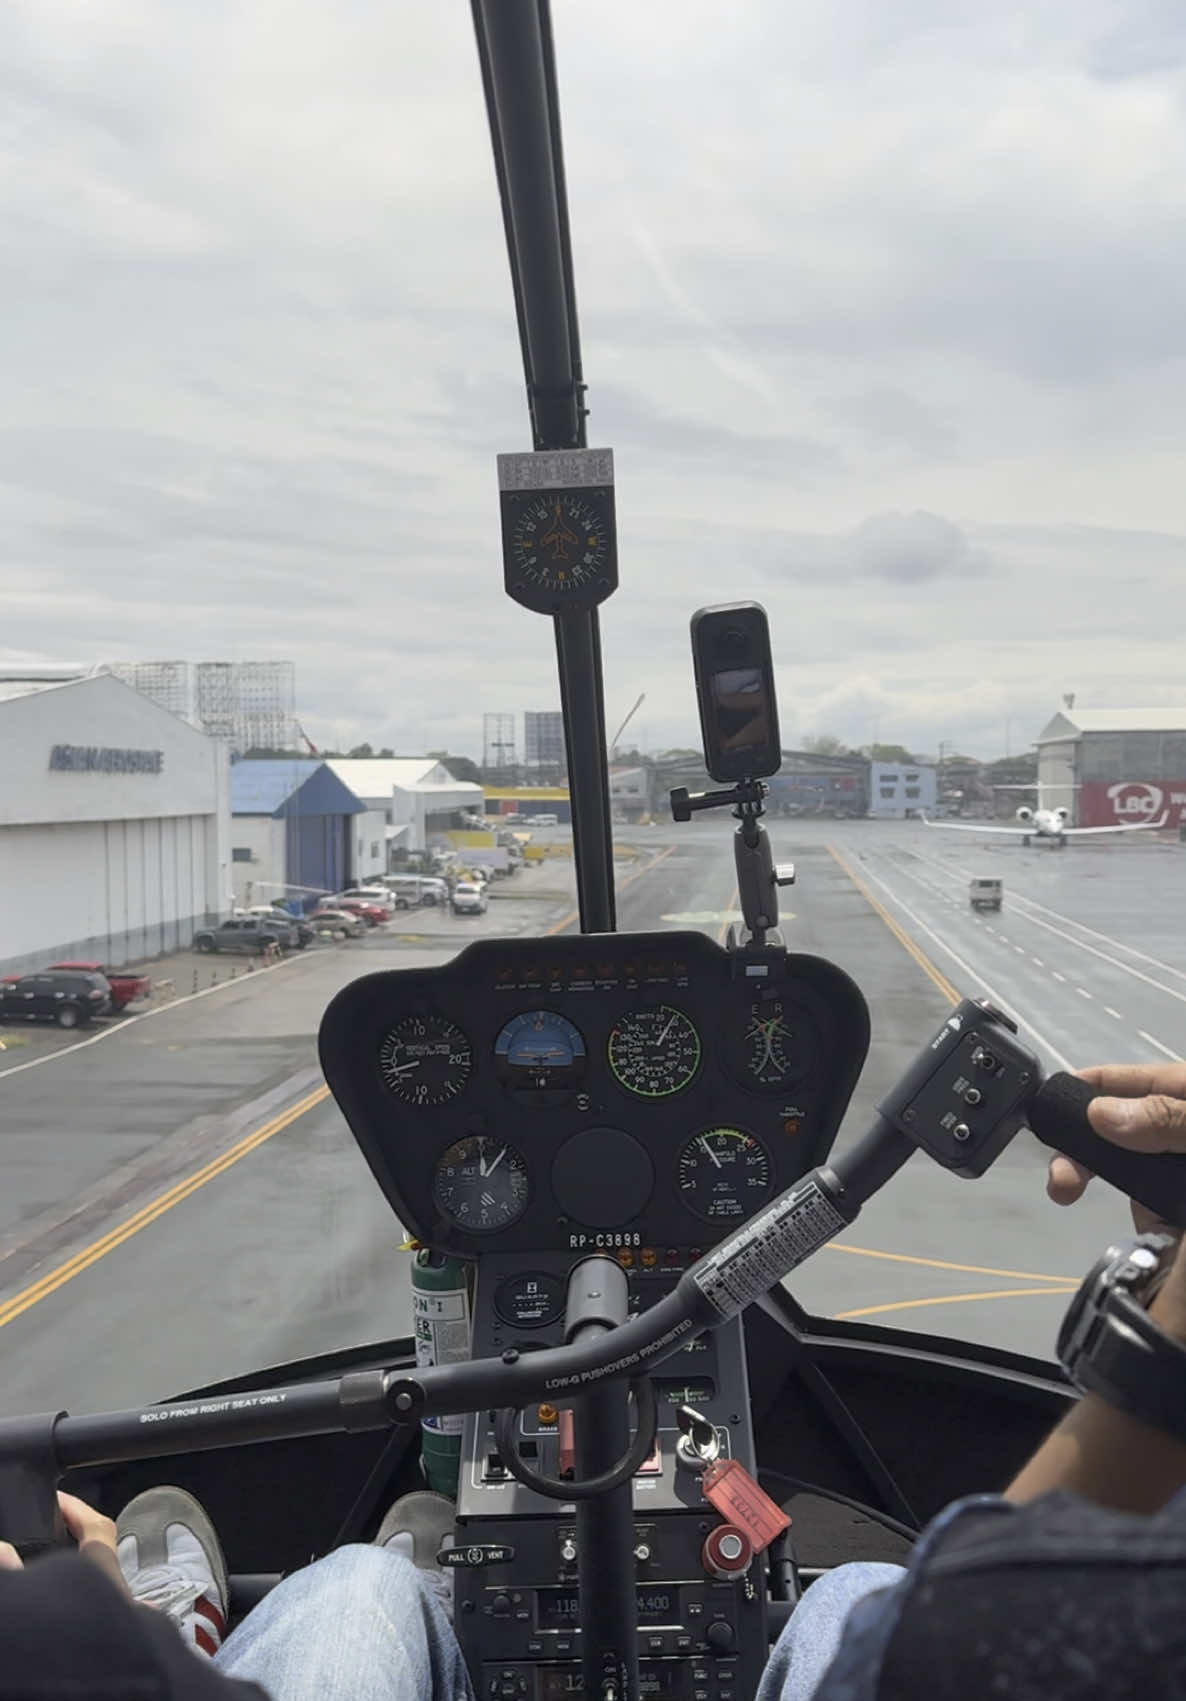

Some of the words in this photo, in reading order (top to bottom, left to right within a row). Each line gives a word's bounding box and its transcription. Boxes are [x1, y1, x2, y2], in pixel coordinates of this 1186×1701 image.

[413, 1025, 425, 1036] 10
[448, 1054, 462, 1065] 20
[415, 1084, 428, 1096] 10
[460, 1202, 469, 1213] 6
[480, 1208, 488, 1218] 5
[545, 1374, 579, 1389] LOW-G
[581, 1353, 640, 1383] PUSHOVERS
[639, 1319, 693, 1358] PROHIBITED
[139, 1412, 168, 1424] SOLO
[170, 1407, 198, 1419] FROM
[200, 1401, 230, 1415] RIGHT
[232, 1397, 257, 1410] SEAT
[259, 1393, 287, 1405] ONLY
[448, 1553, 464, 1562] PULL
[488, 1550, 504, 1559] VENT
